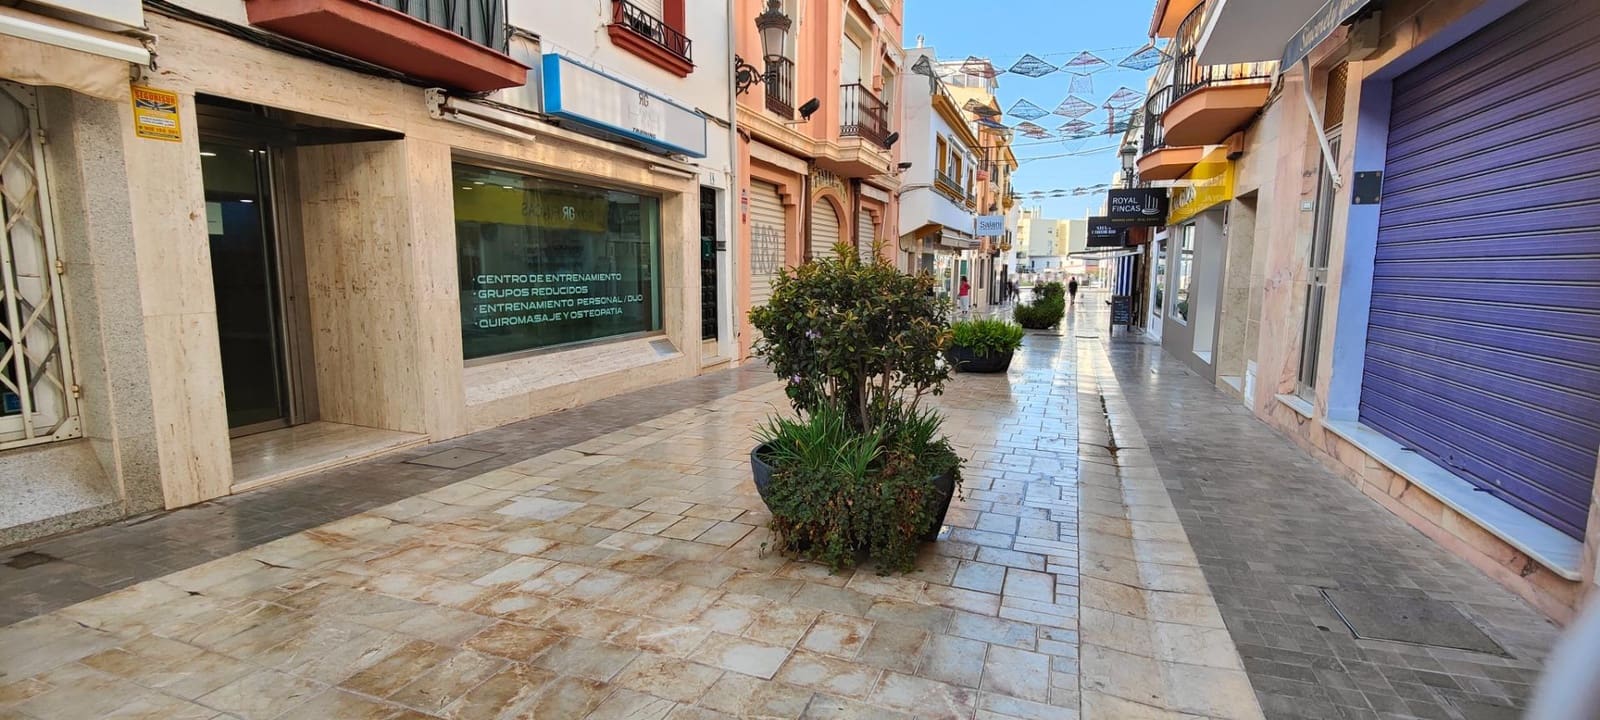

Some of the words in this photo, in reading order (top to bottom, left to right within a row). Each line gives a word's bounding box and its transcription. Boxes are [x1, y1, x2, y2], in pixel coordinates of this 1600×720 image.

[1112, 205, 1141, 213] FINCAS
[477, 274, 528, 285] CENTRO
[529, 274, 544, 283] DE
[545, 273, 622, 283] ENTRENAMIENTO
[478, 287, 530, 299] GRUPOS
[531, 286, 589, 296] REDUCIDOS
[479, 299, 574, 314] ENTRENAMIENTO
[576, 296, 622, 306] PERSONAL
[627, 294, 643, 303] DUO
[479, 312, 562, 329] QUIROMASAJE
[563, 311, 569, 321] Y
[570, 307, 623, 320] OSTEOPATIA
